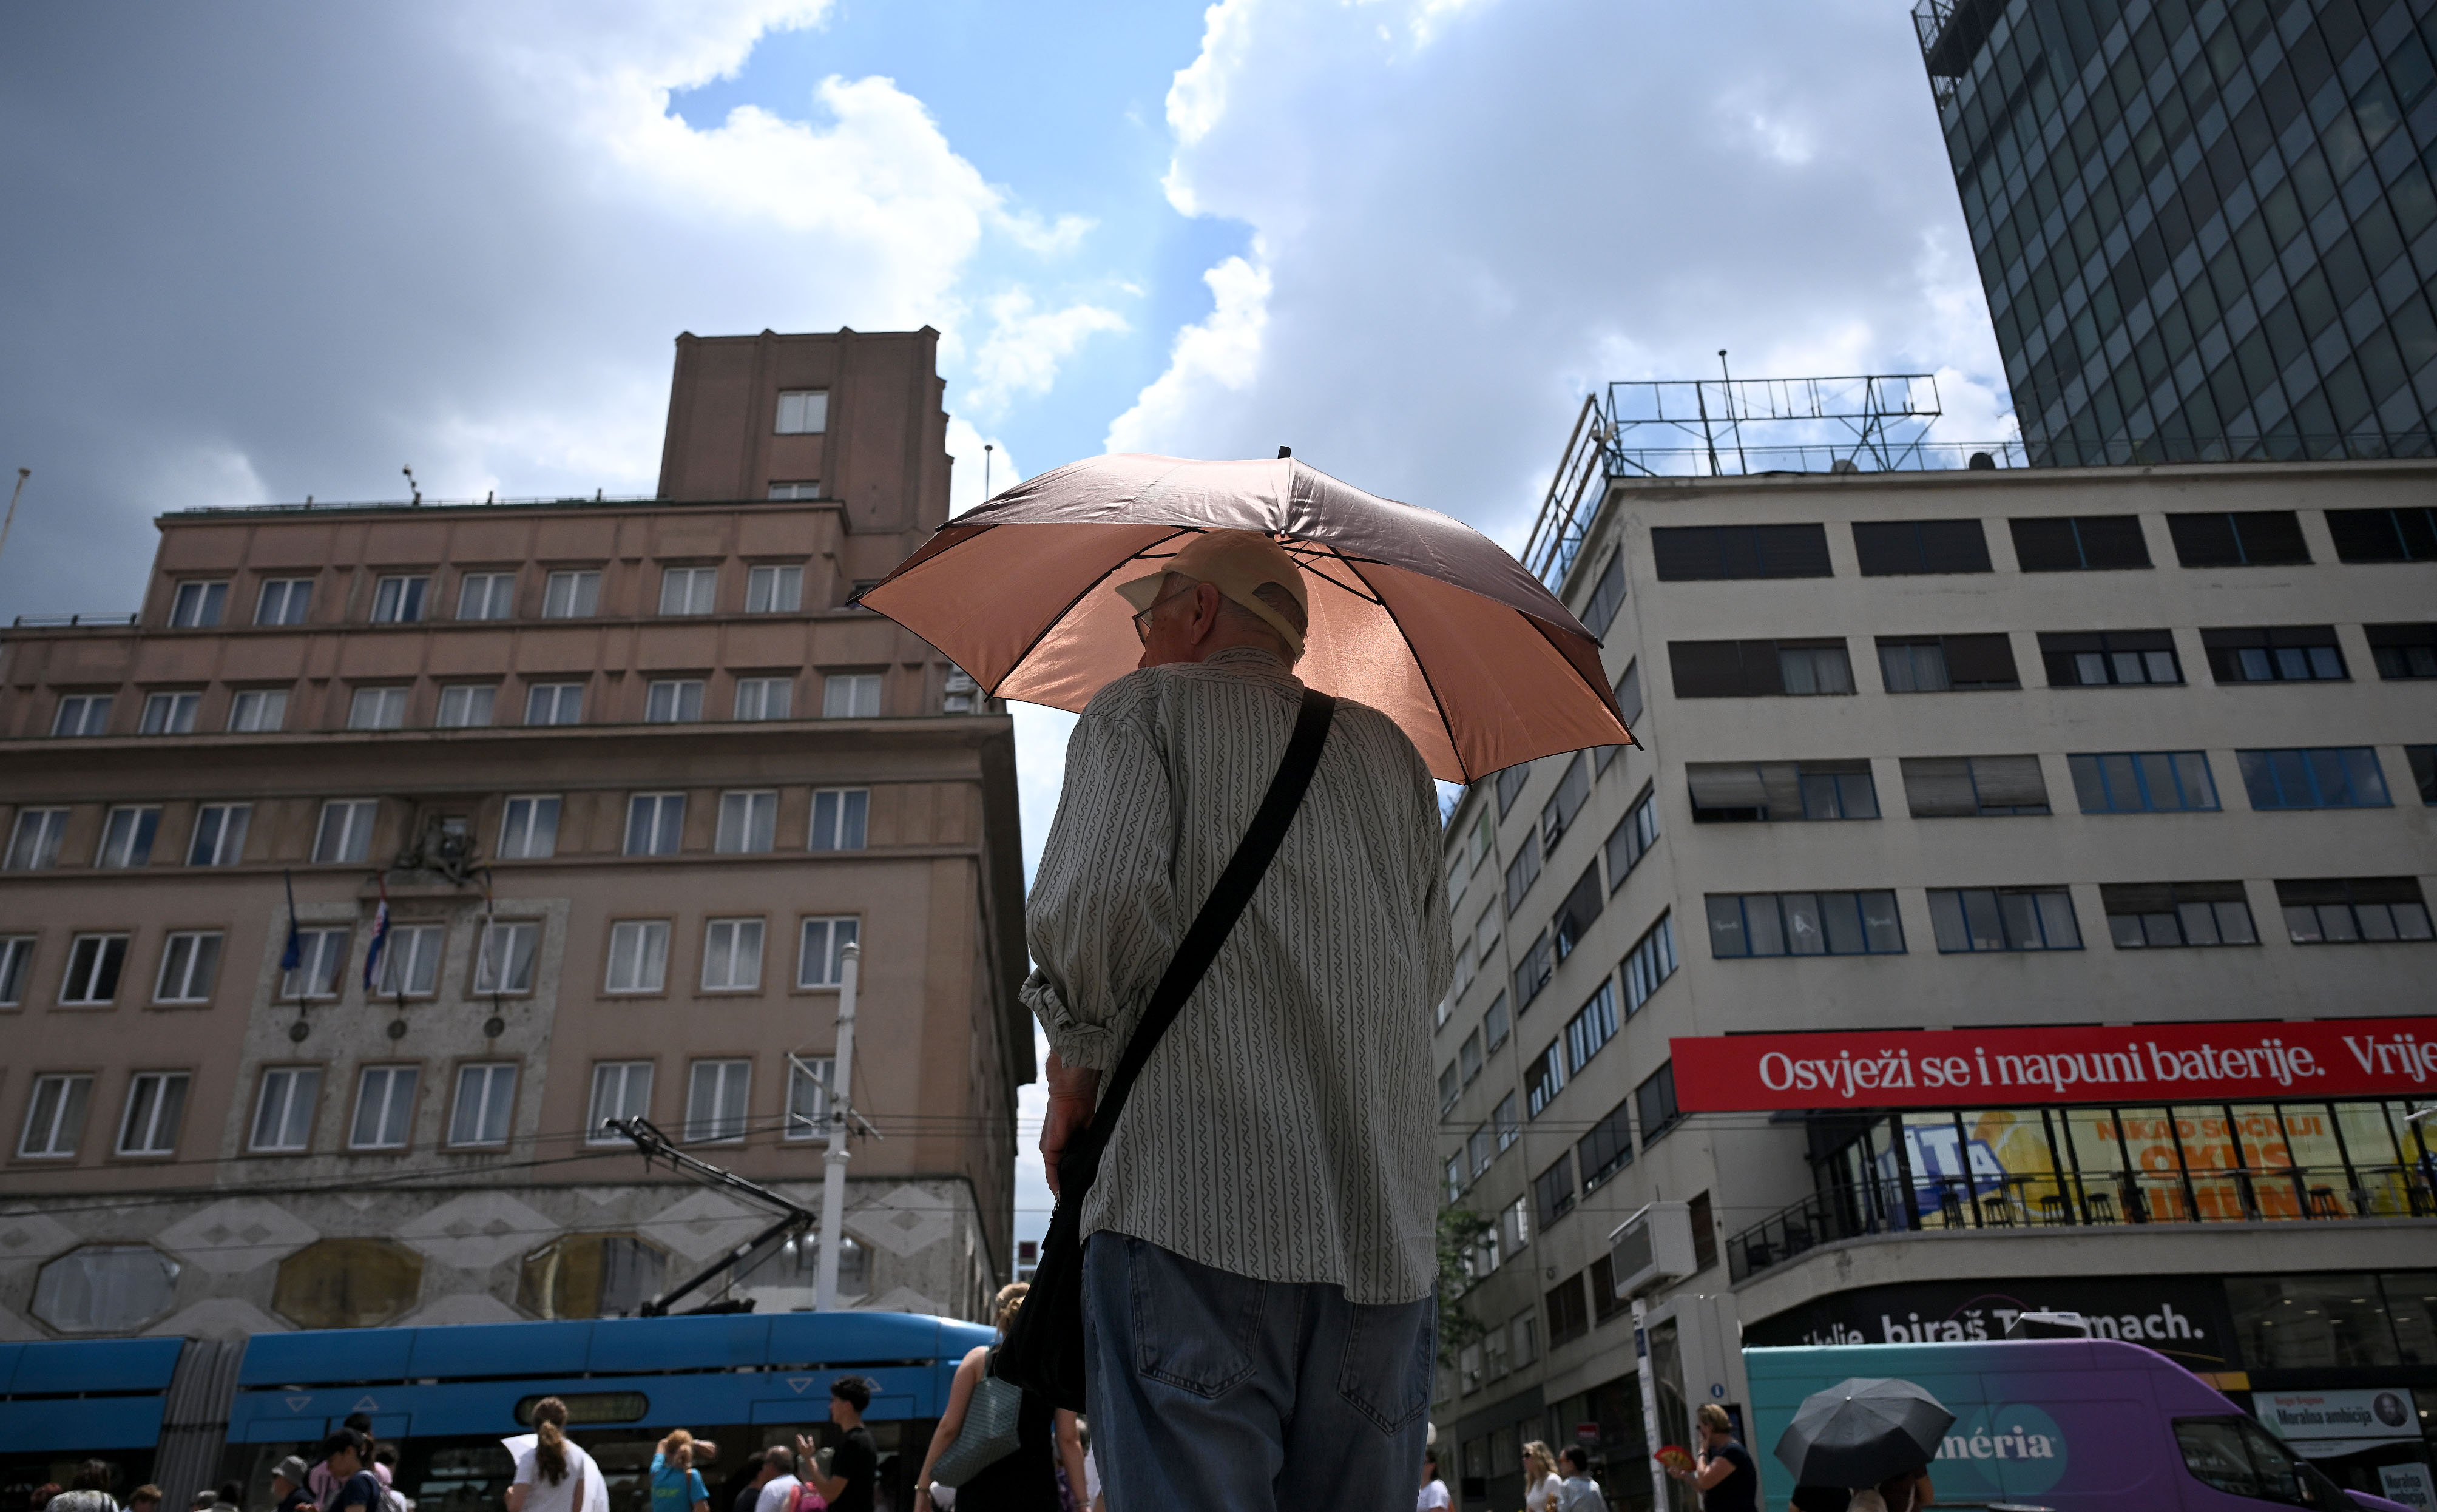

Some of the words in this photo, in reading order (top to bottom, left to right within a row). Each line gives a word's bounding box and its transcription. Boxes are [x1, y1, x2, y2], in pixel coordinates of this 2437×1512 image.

[1759, 1049, 1916, 1098] Osvježi
[1921, 1056, 1970, 1087] se
[1975, 1047, 1992, 1085] i
[1995, 1043, 2146, 1093] napuni
[2146, 1038, 2325, 1085] baterije.
[2096, 1119, 2196, 1141] NIKAD
[2201, 1111, 2323, 1139] SOČNIJI
[1881, 1309, 1989, 1344] biraš
